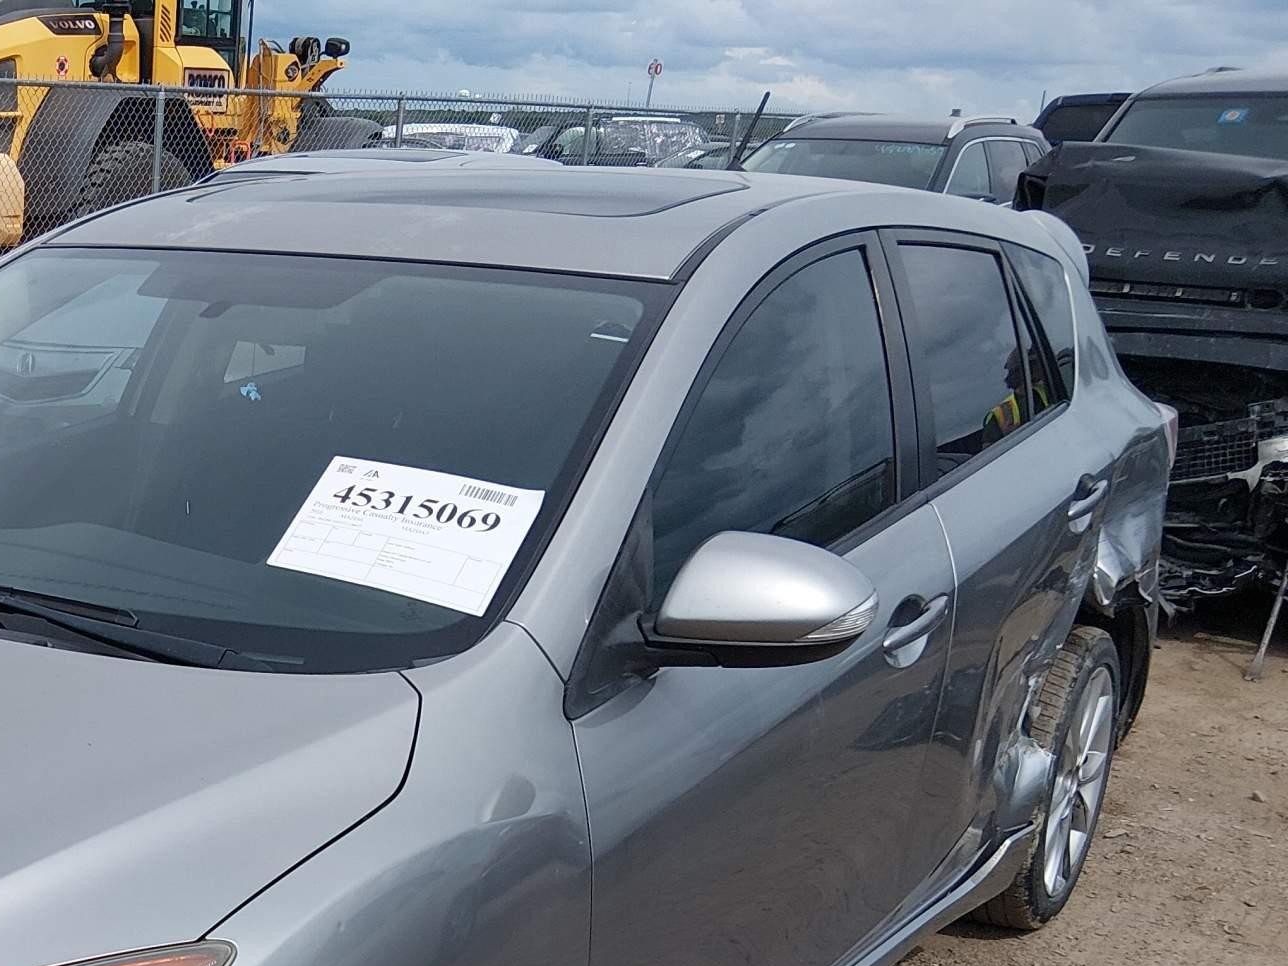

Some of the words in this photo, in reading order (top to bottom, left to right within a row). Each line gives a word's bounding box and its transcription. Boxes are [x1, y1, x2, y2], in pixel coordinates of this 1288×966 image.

[49, 19, 96, 29] VOLVO
[313, 500, 360, 515] Progressive
[362, 509, 398, 521] Casualty
[401, 516, 443, 531] Insurance
[332, 484, 501, 533] 45315069
